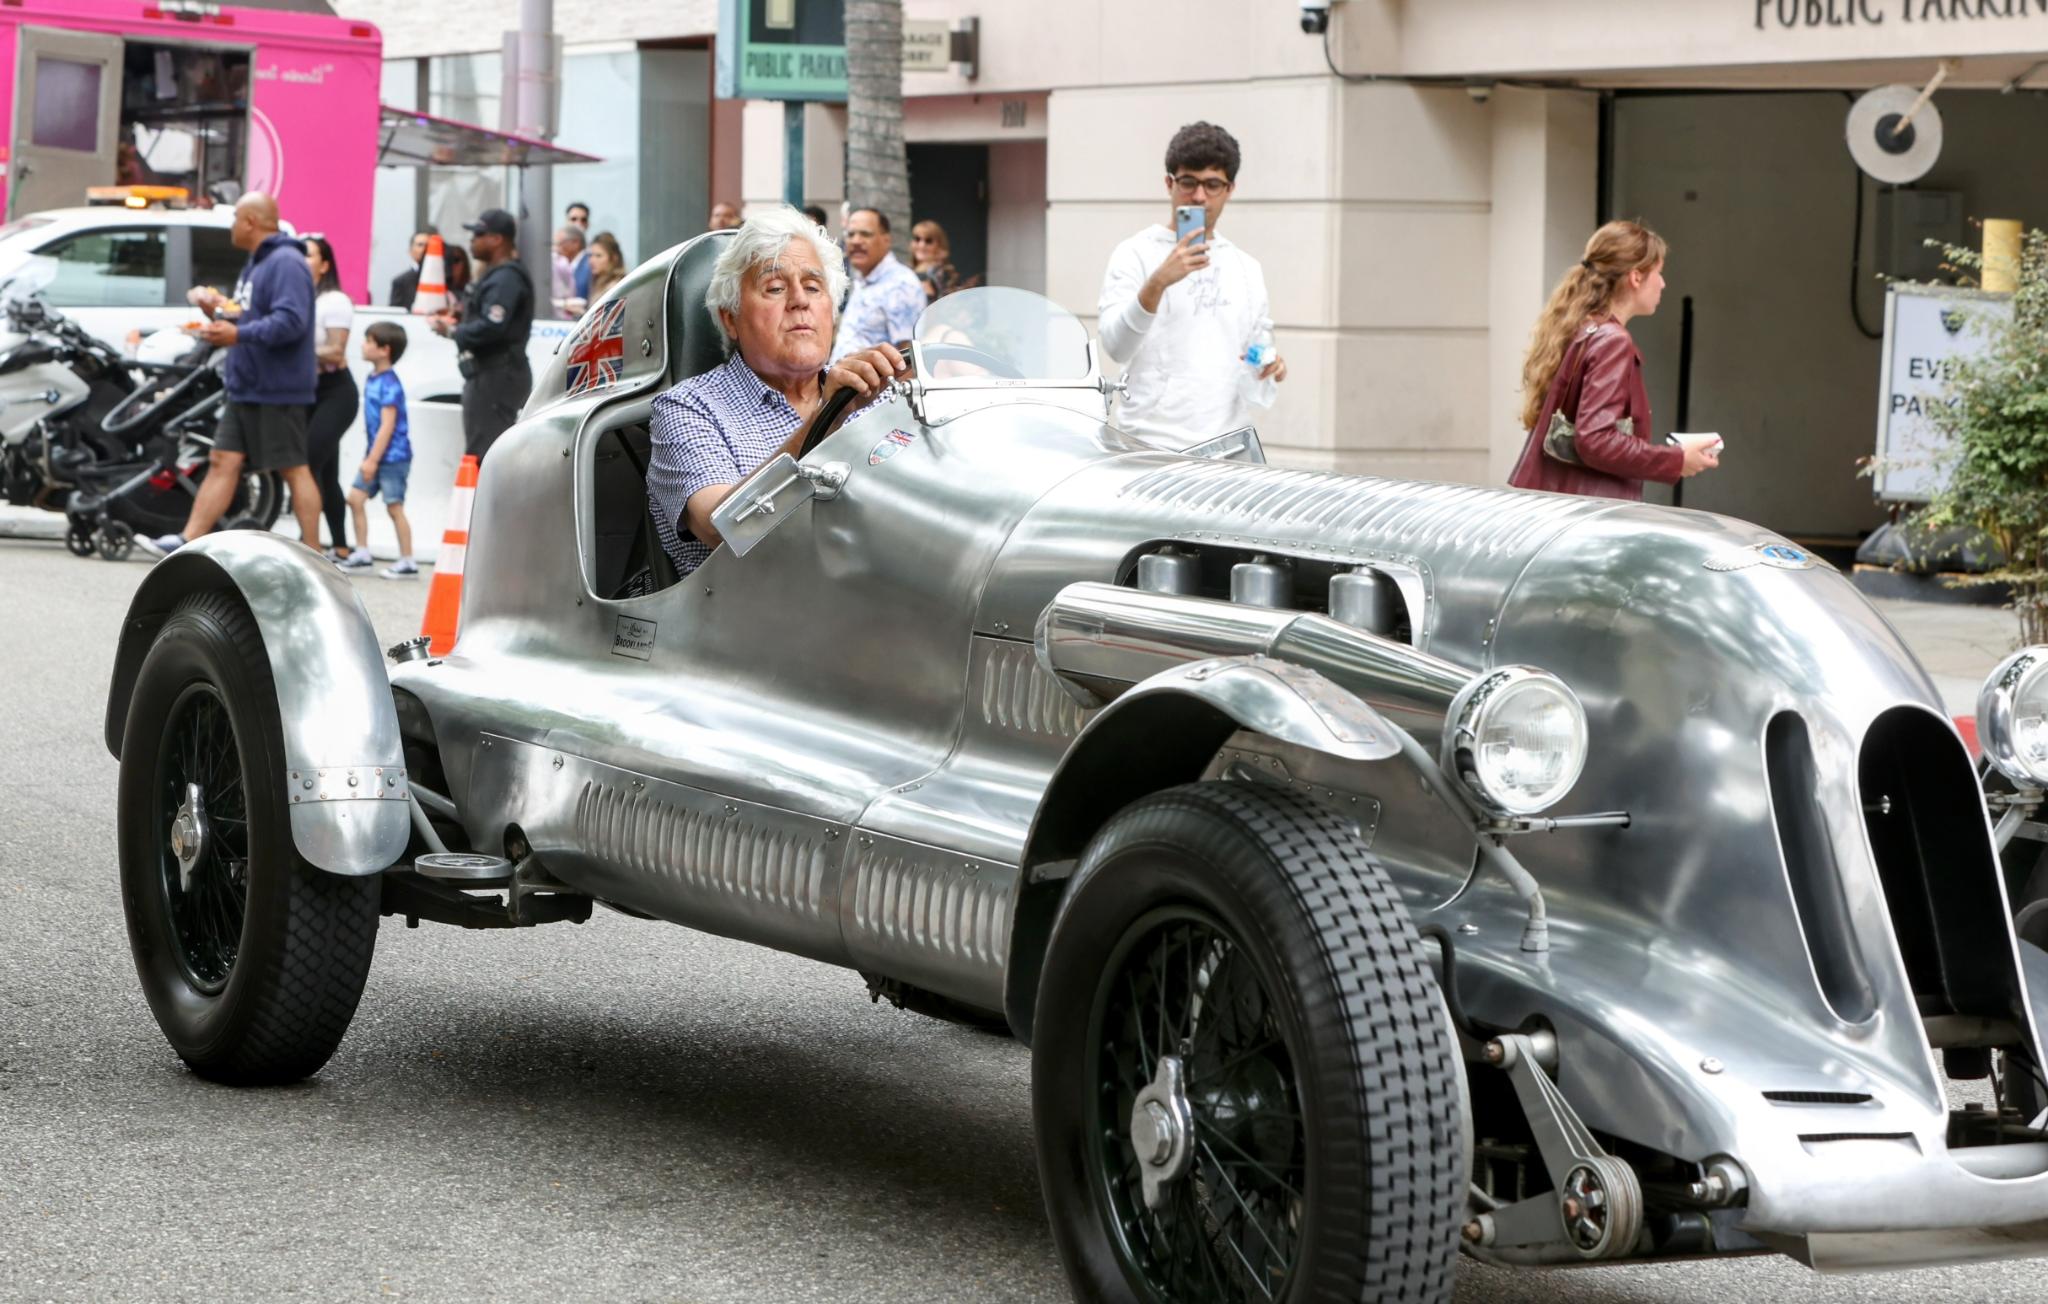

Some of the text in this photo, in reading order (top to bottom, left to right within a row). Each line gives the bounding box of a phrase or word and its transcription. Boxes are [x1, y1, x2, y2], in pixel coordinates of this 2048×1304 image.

[1754, 0, 1883, 29] PUBLIC
[901, 33, 943, 45] ARAGE
[747, 51, 793, 78] PUBLIC
